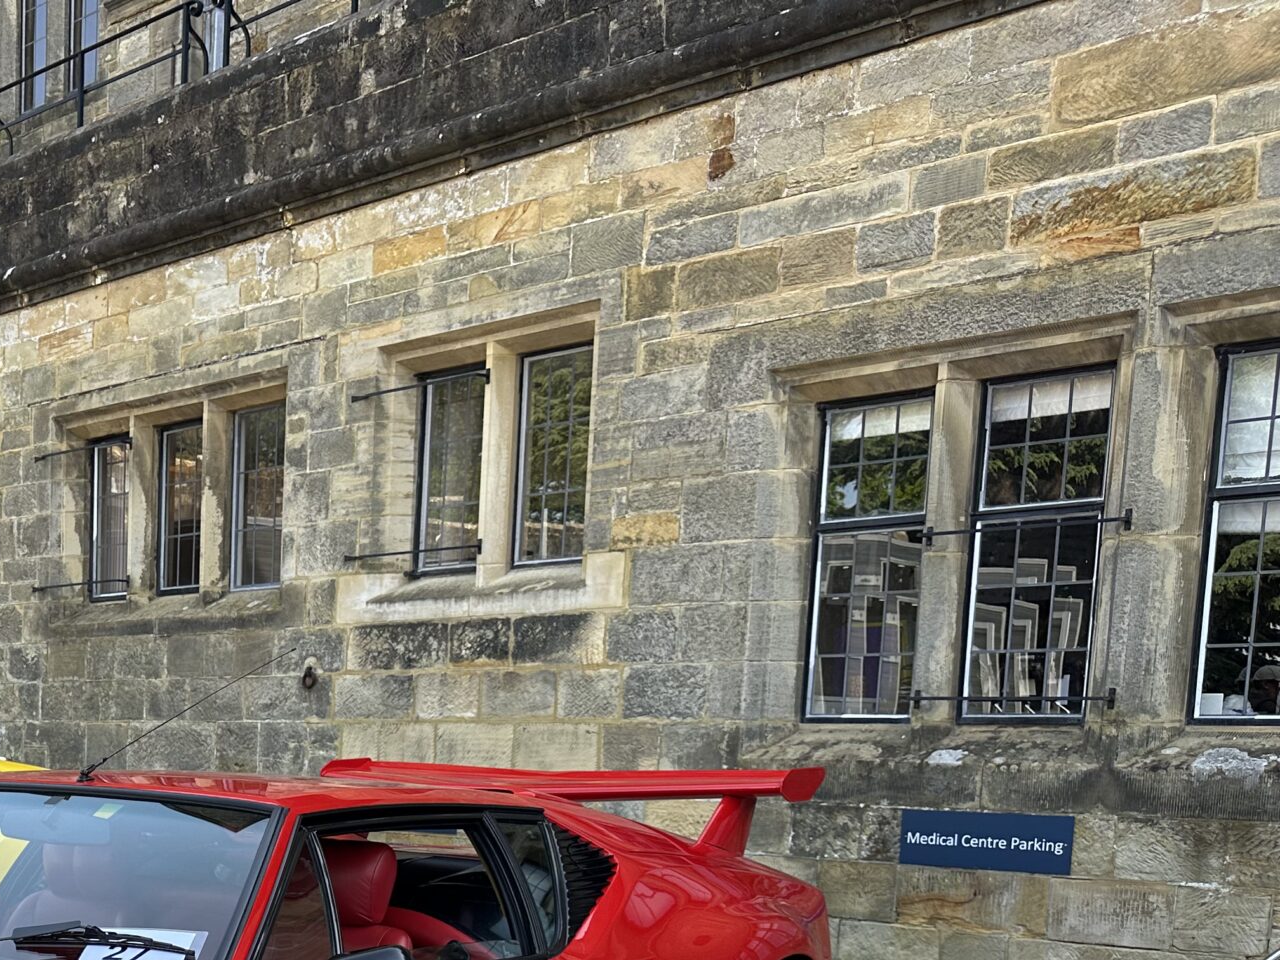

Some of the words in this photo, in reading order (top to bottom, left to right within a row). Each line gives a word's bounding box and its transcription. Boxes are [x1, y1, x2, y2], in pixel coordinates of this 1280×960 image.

[906, 831, 958, 847] Medical
[961, 834, 1007, 849] Centre
[1010, 837, 1064, 855] Parking
